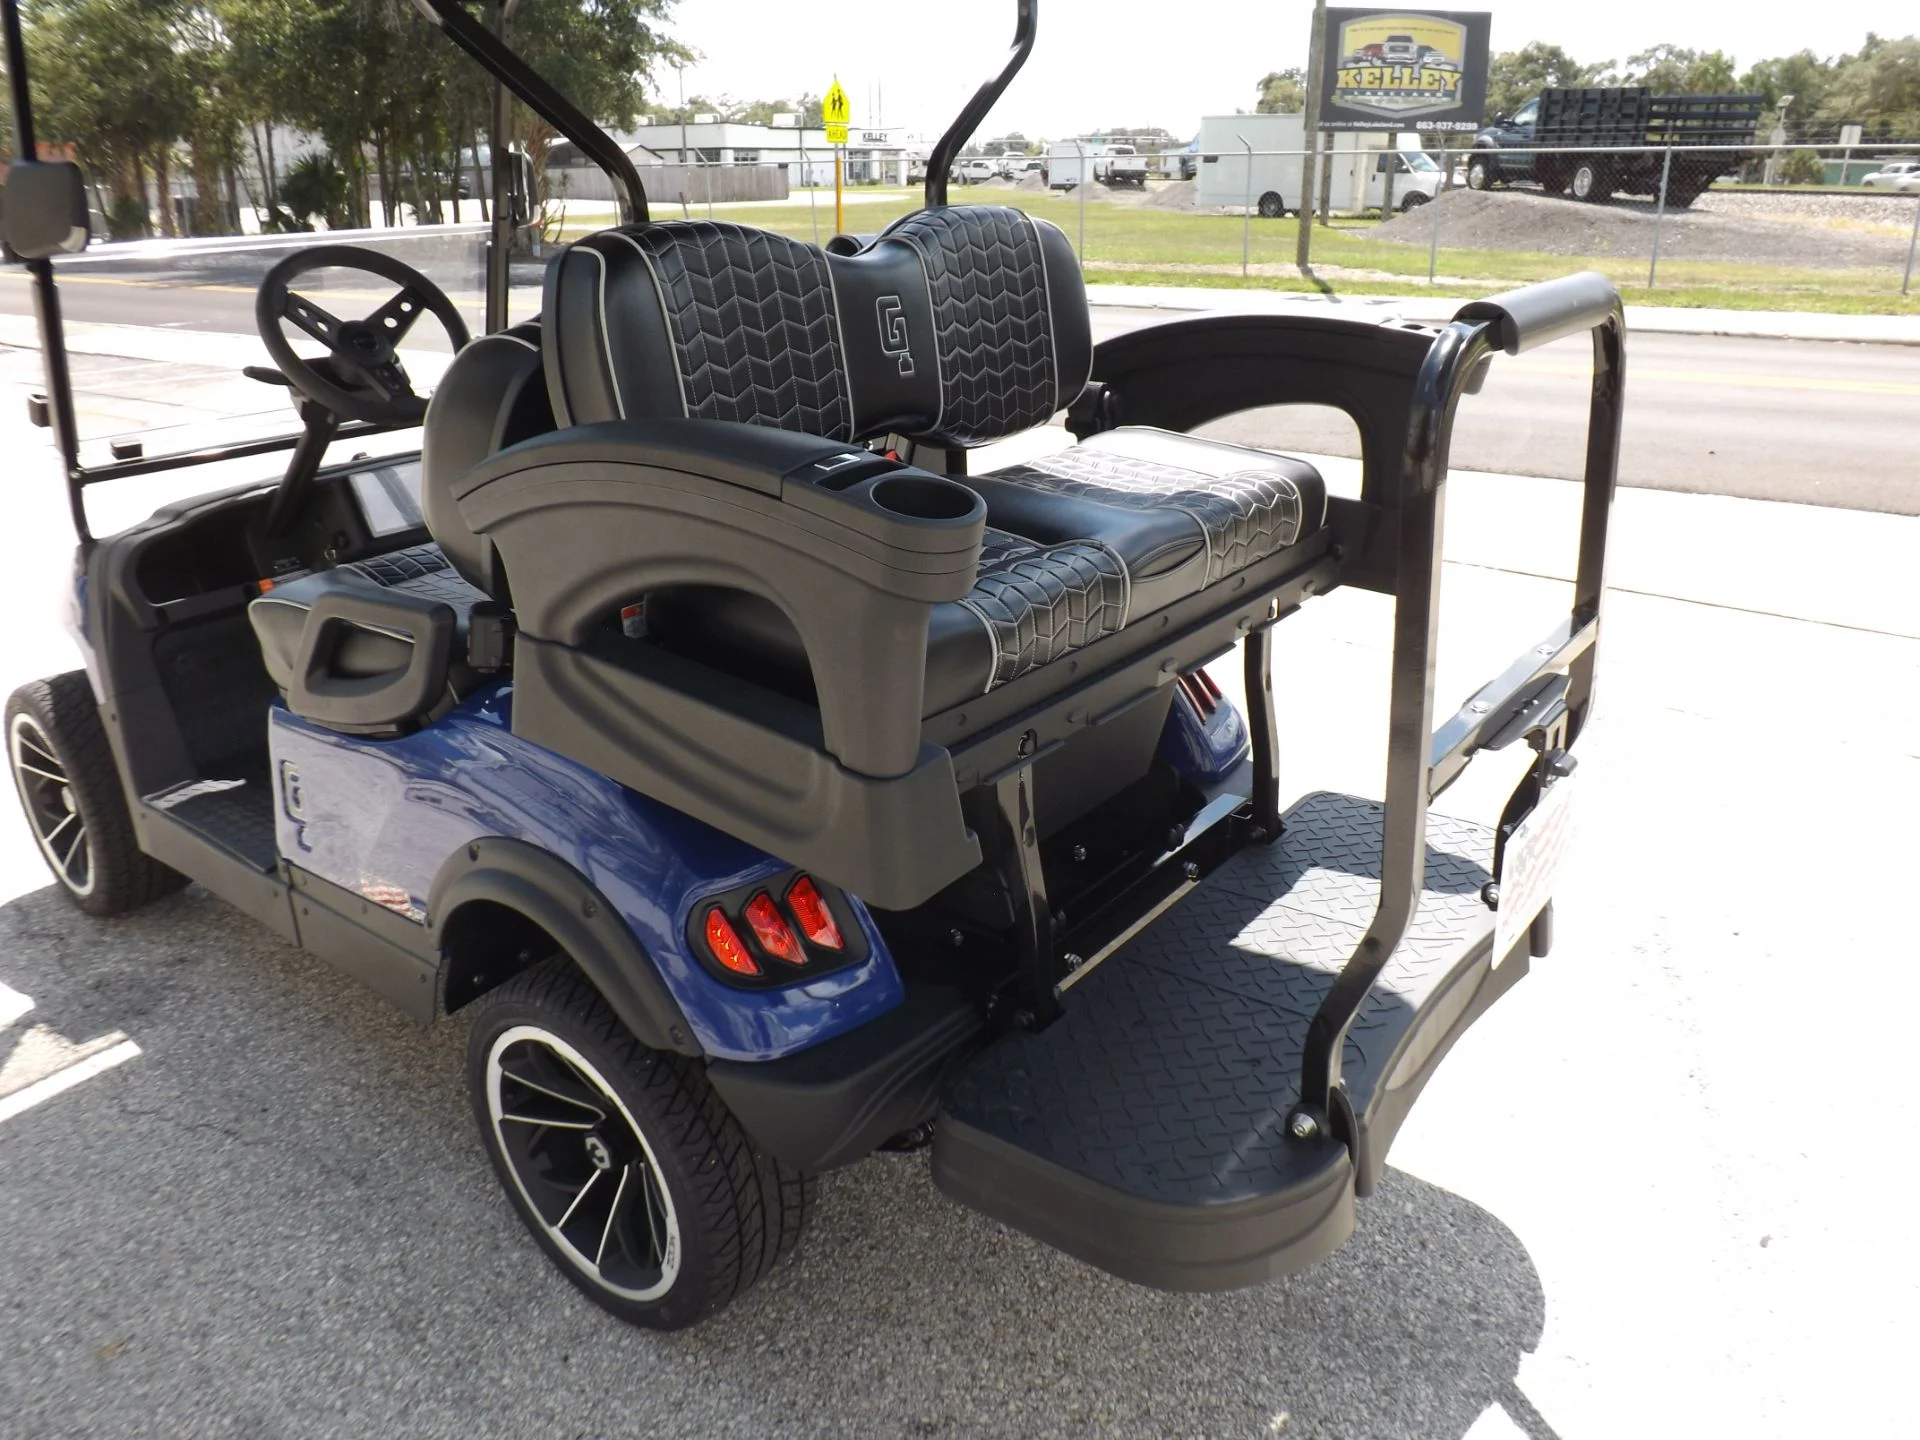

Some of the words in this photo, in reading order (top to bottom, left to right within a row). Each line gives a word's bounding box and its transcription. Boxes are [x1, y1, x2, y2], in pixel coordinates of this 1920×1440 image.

[1336, 66, 1462, 91] KELLEY
[828, 129, 847, 140] AHEAD
[862, 132, 888, 141] KELLEY
